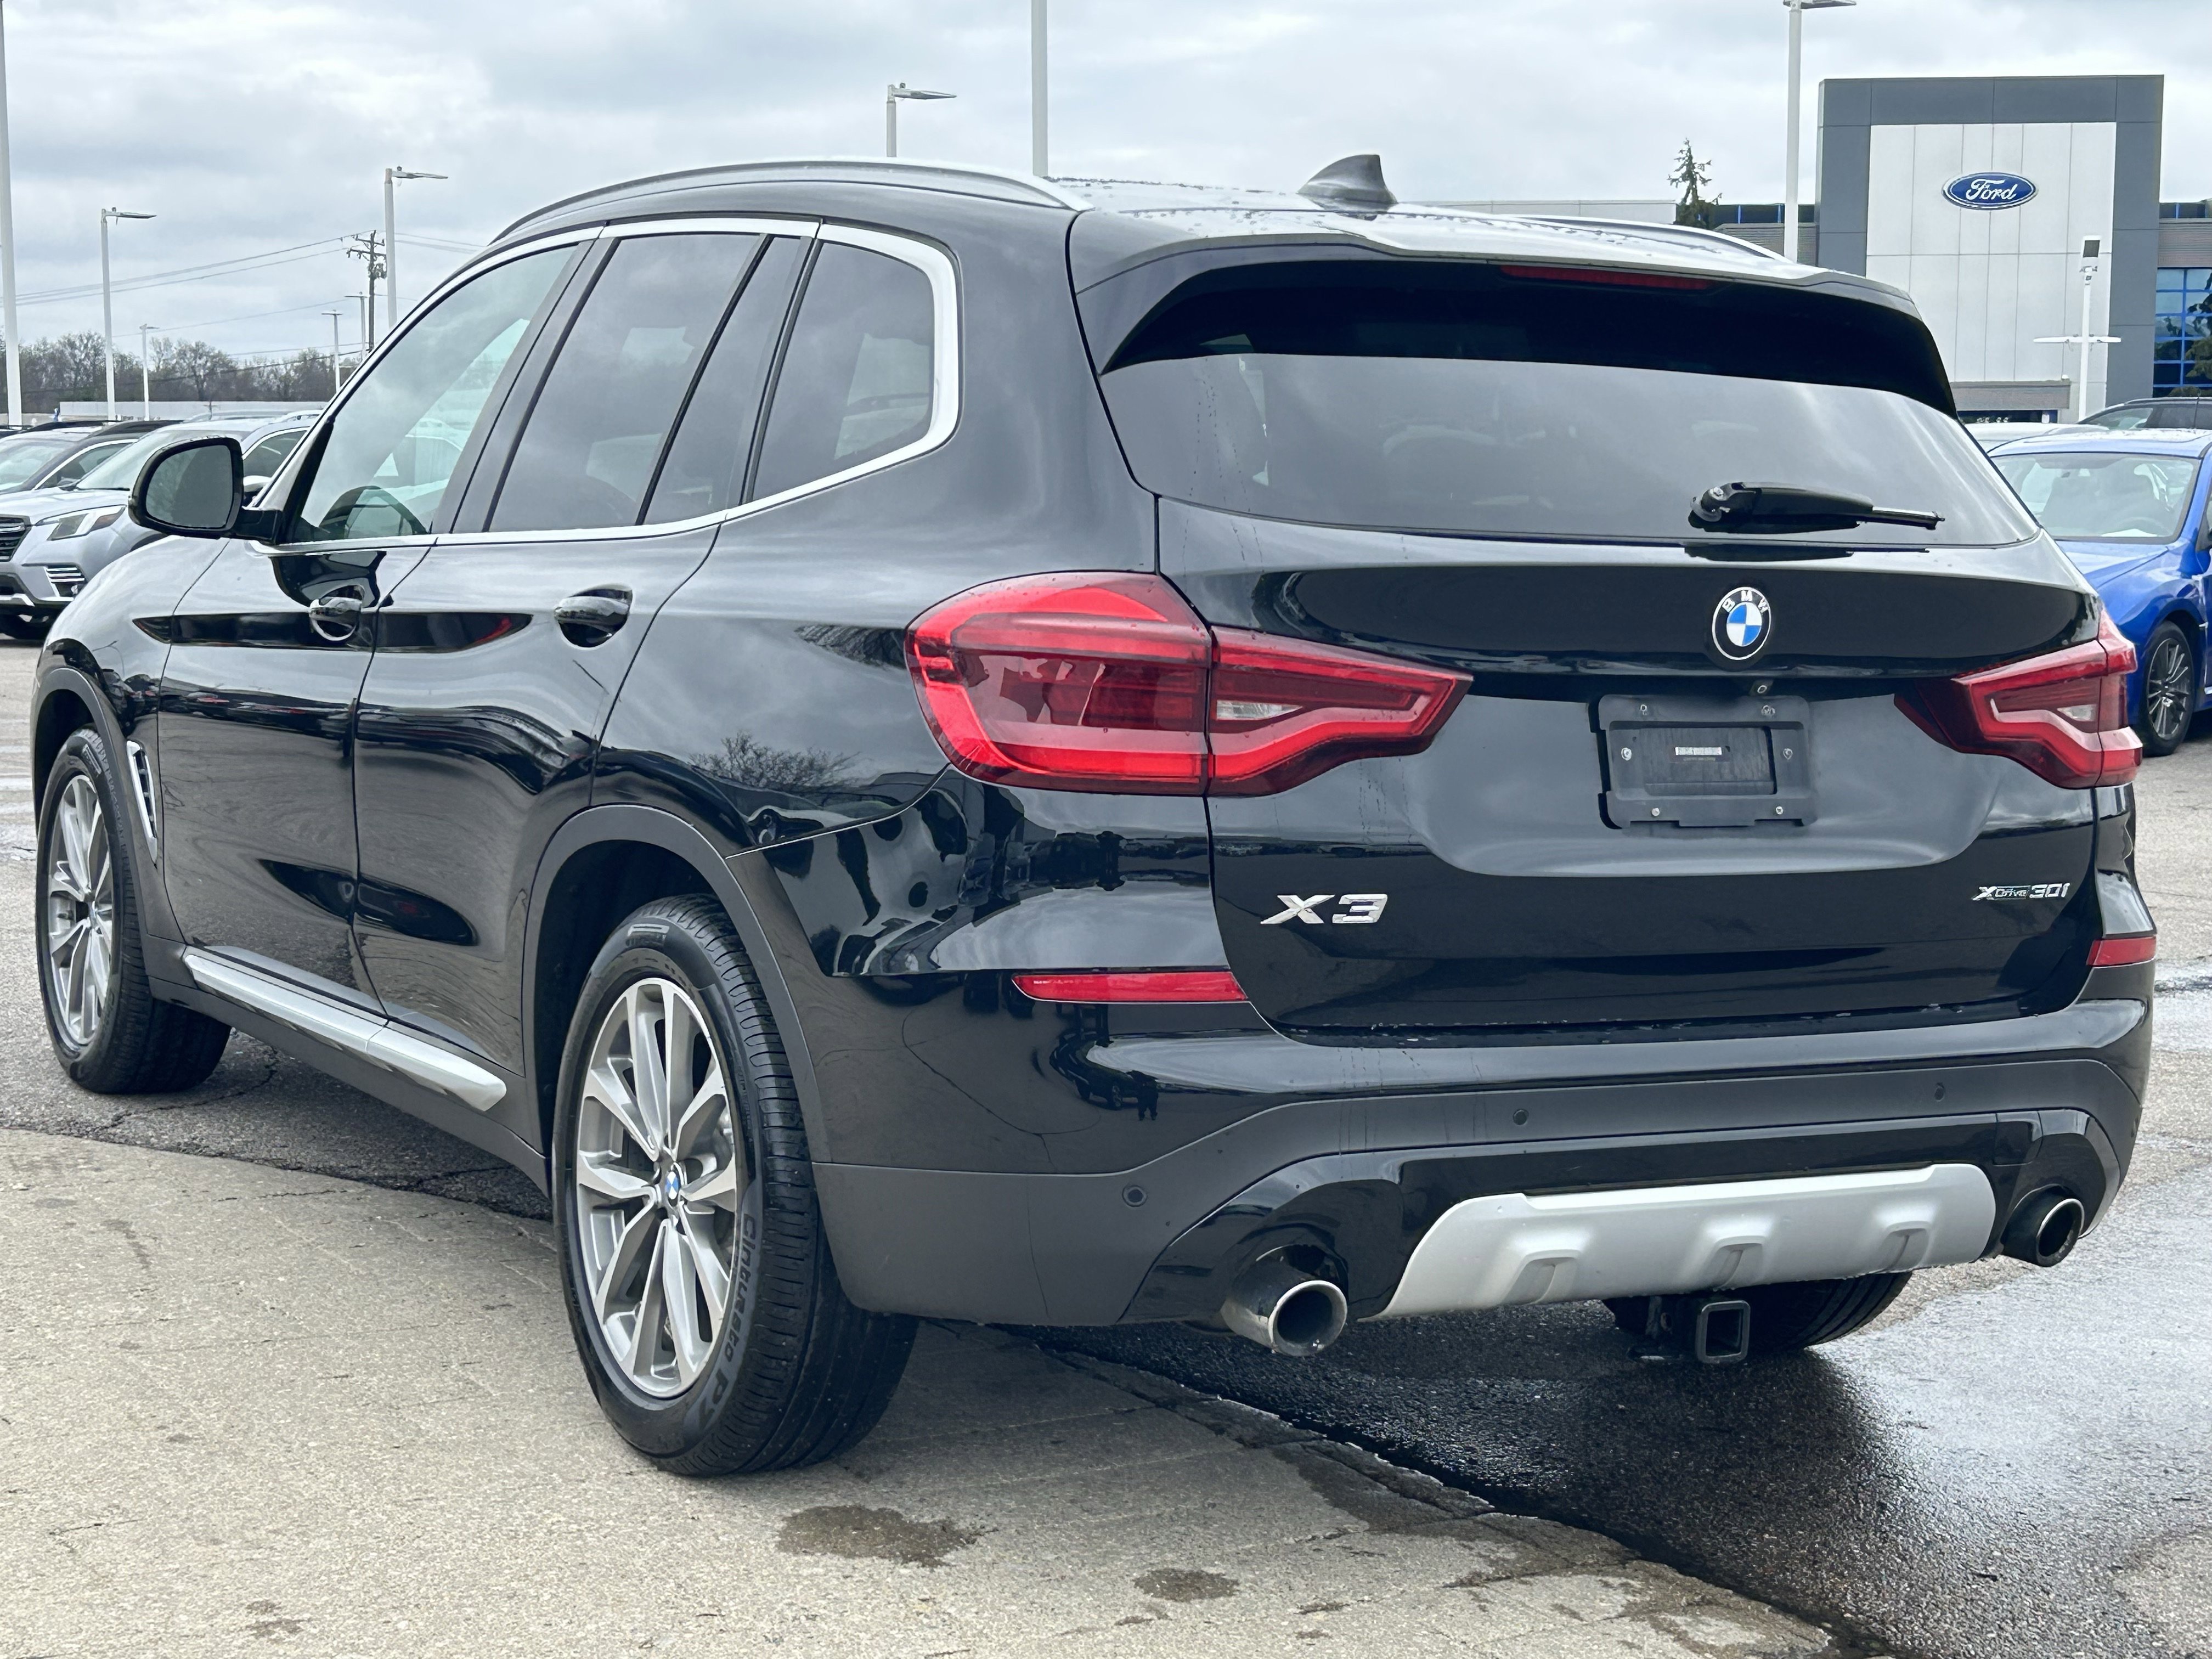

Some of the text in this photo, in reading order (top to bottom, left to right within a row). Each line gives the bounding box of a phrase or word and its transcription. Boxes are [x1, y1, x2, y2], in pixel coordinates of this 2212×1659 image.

[1965, 178, 2018, 200] Ford
[1722, 590, 1769, 613] BMW
[1260, 894, 1388, 924] X3
